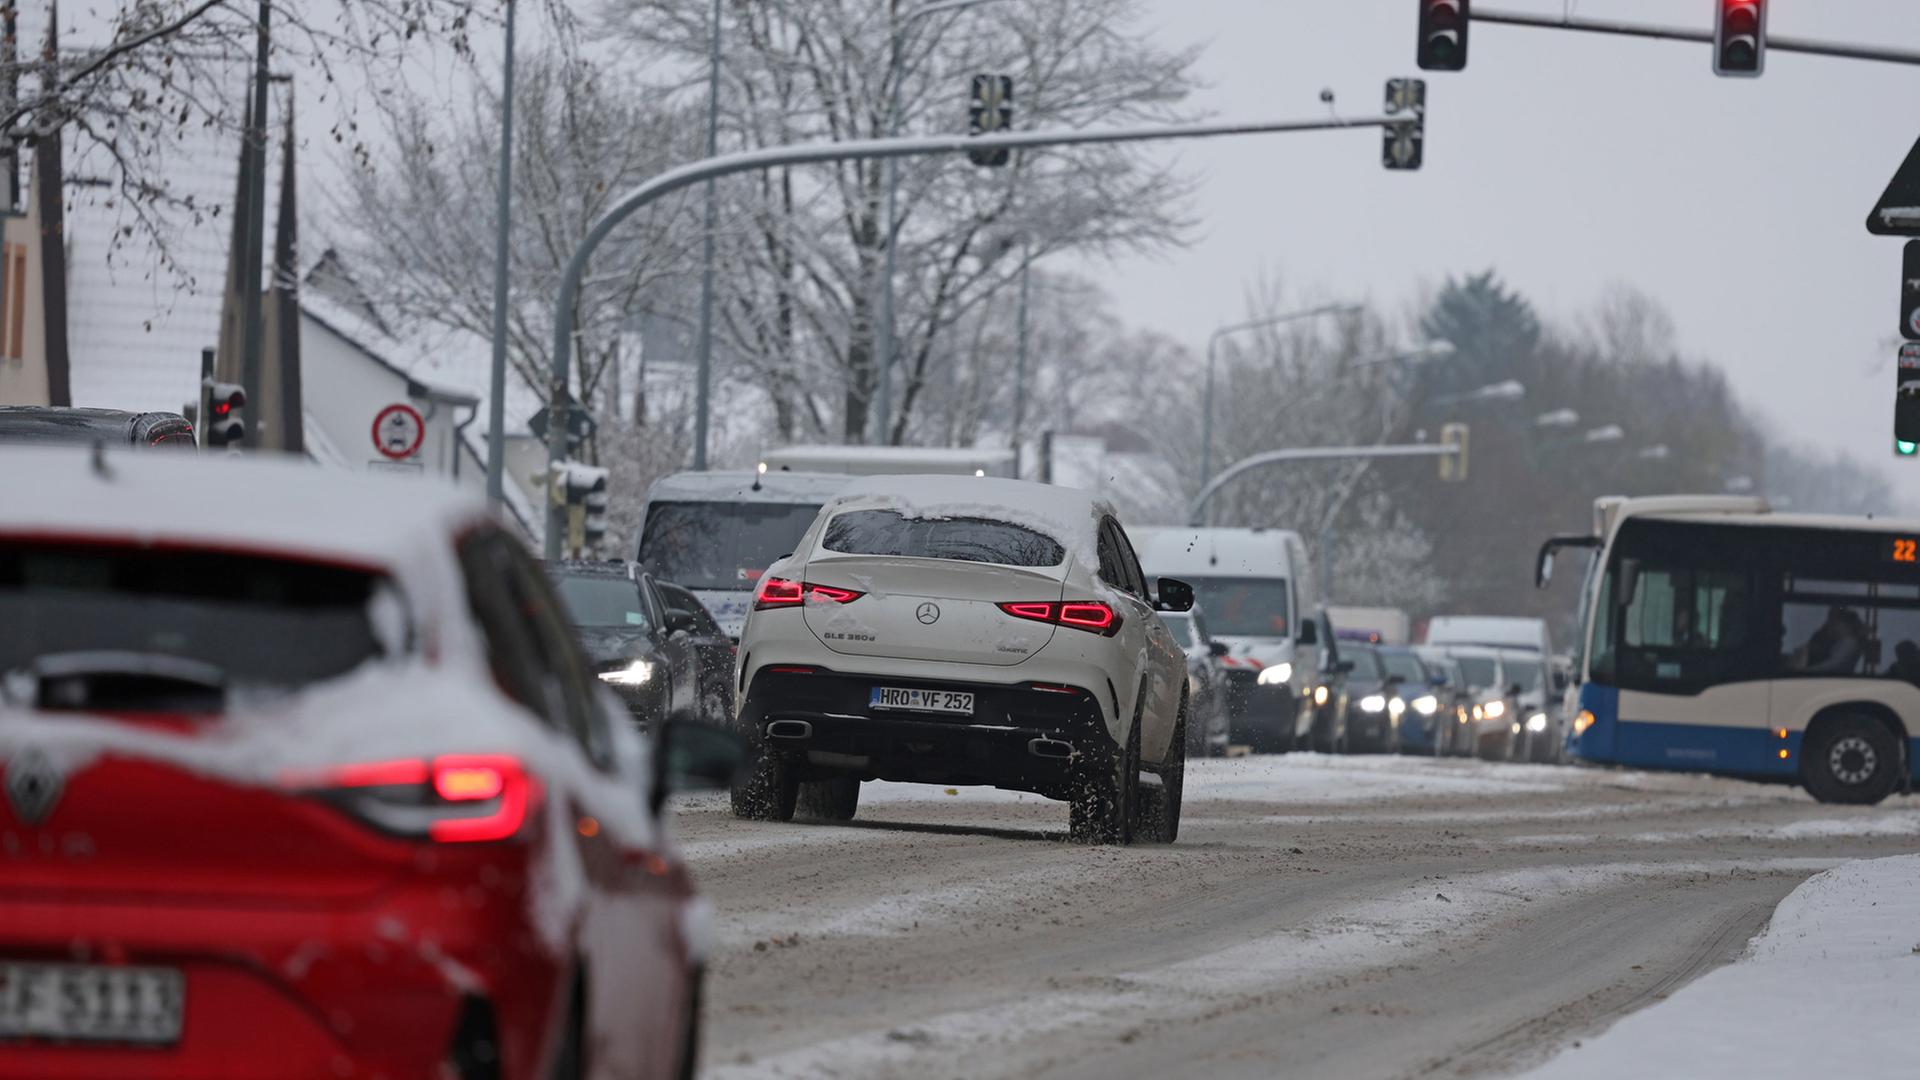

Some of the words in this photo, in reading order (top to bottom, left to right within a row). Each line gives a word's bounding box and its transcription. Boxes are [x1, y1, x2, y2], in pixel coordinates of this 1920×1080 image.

[1893, 539, 1916, 561] 22
[824, 632, 844, 640] GLE
[880, 688, 910, 706] HRO
[921, 691, 941, 707] YF
[943, 693, 972, 711] 252
